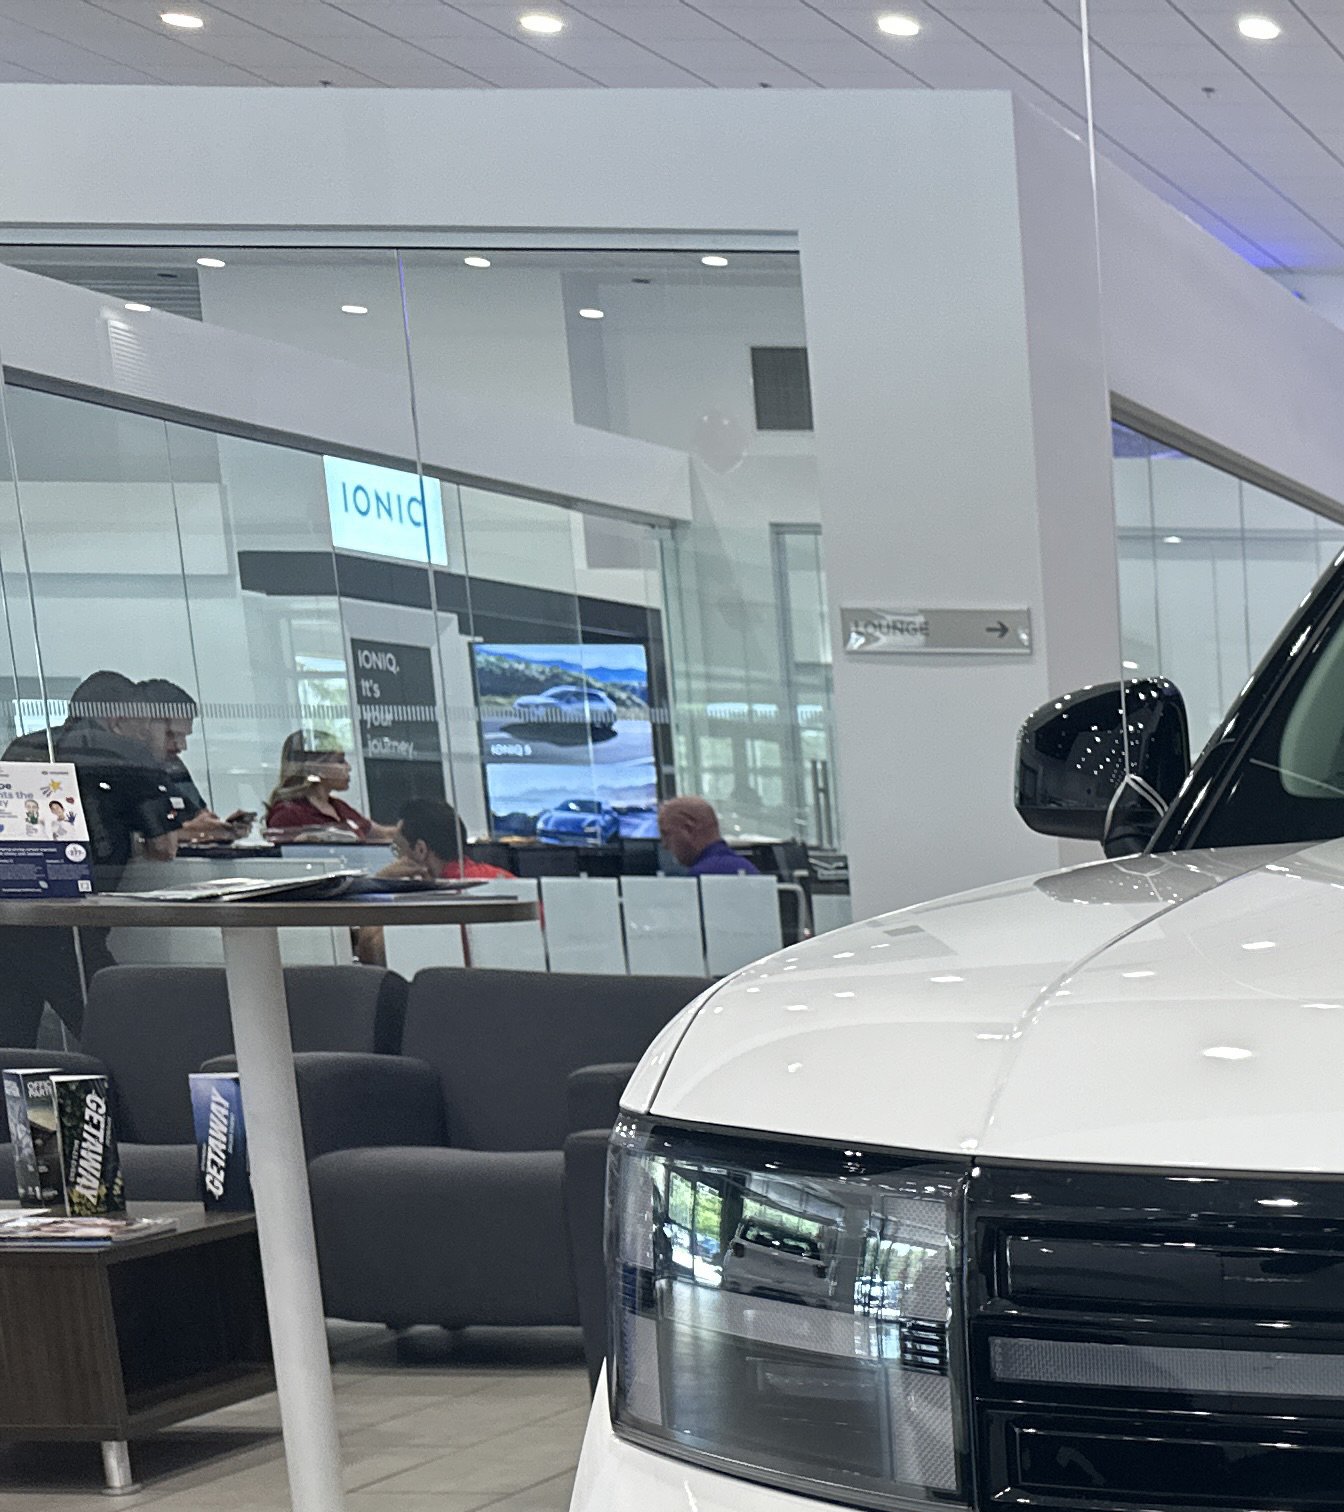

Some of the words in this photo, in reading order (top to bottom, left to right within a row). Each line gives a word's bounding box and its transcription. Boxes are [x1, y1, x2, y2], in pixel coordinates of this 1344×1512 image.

[853, 619, 930, 637] LOUNGE
[74, 1090, 107, 1206] GETAWAY
[205, 1086, 230, 1199] GETAWAY
